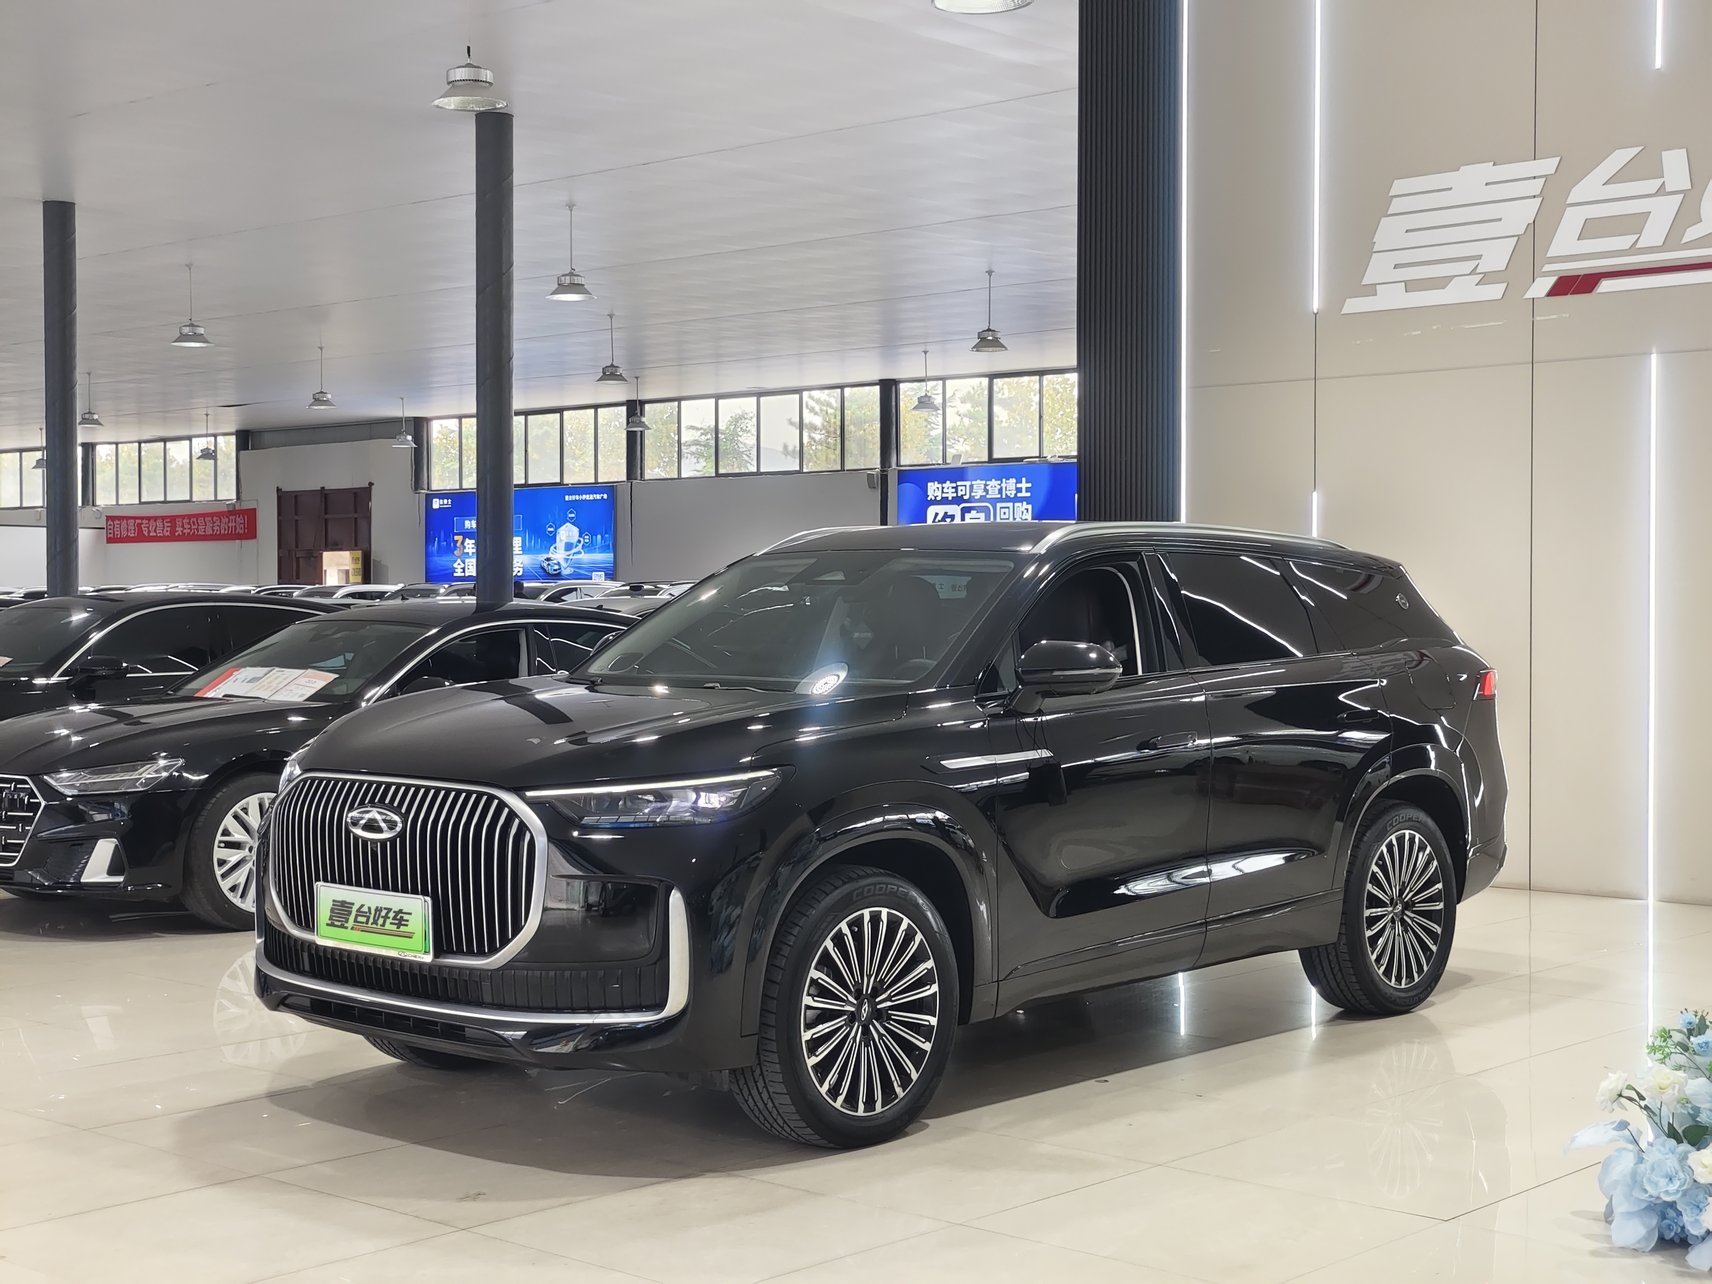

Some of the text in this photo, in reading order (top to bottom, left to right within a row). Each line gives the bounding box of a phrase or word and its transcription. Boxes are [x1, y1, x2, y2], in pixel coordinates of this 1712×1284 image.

[1341, 145, 1712, 315] 壹台
[927, 477, 1032, 501] 购车可享查博士
[326, 899, 413, 930] 壹台好车
